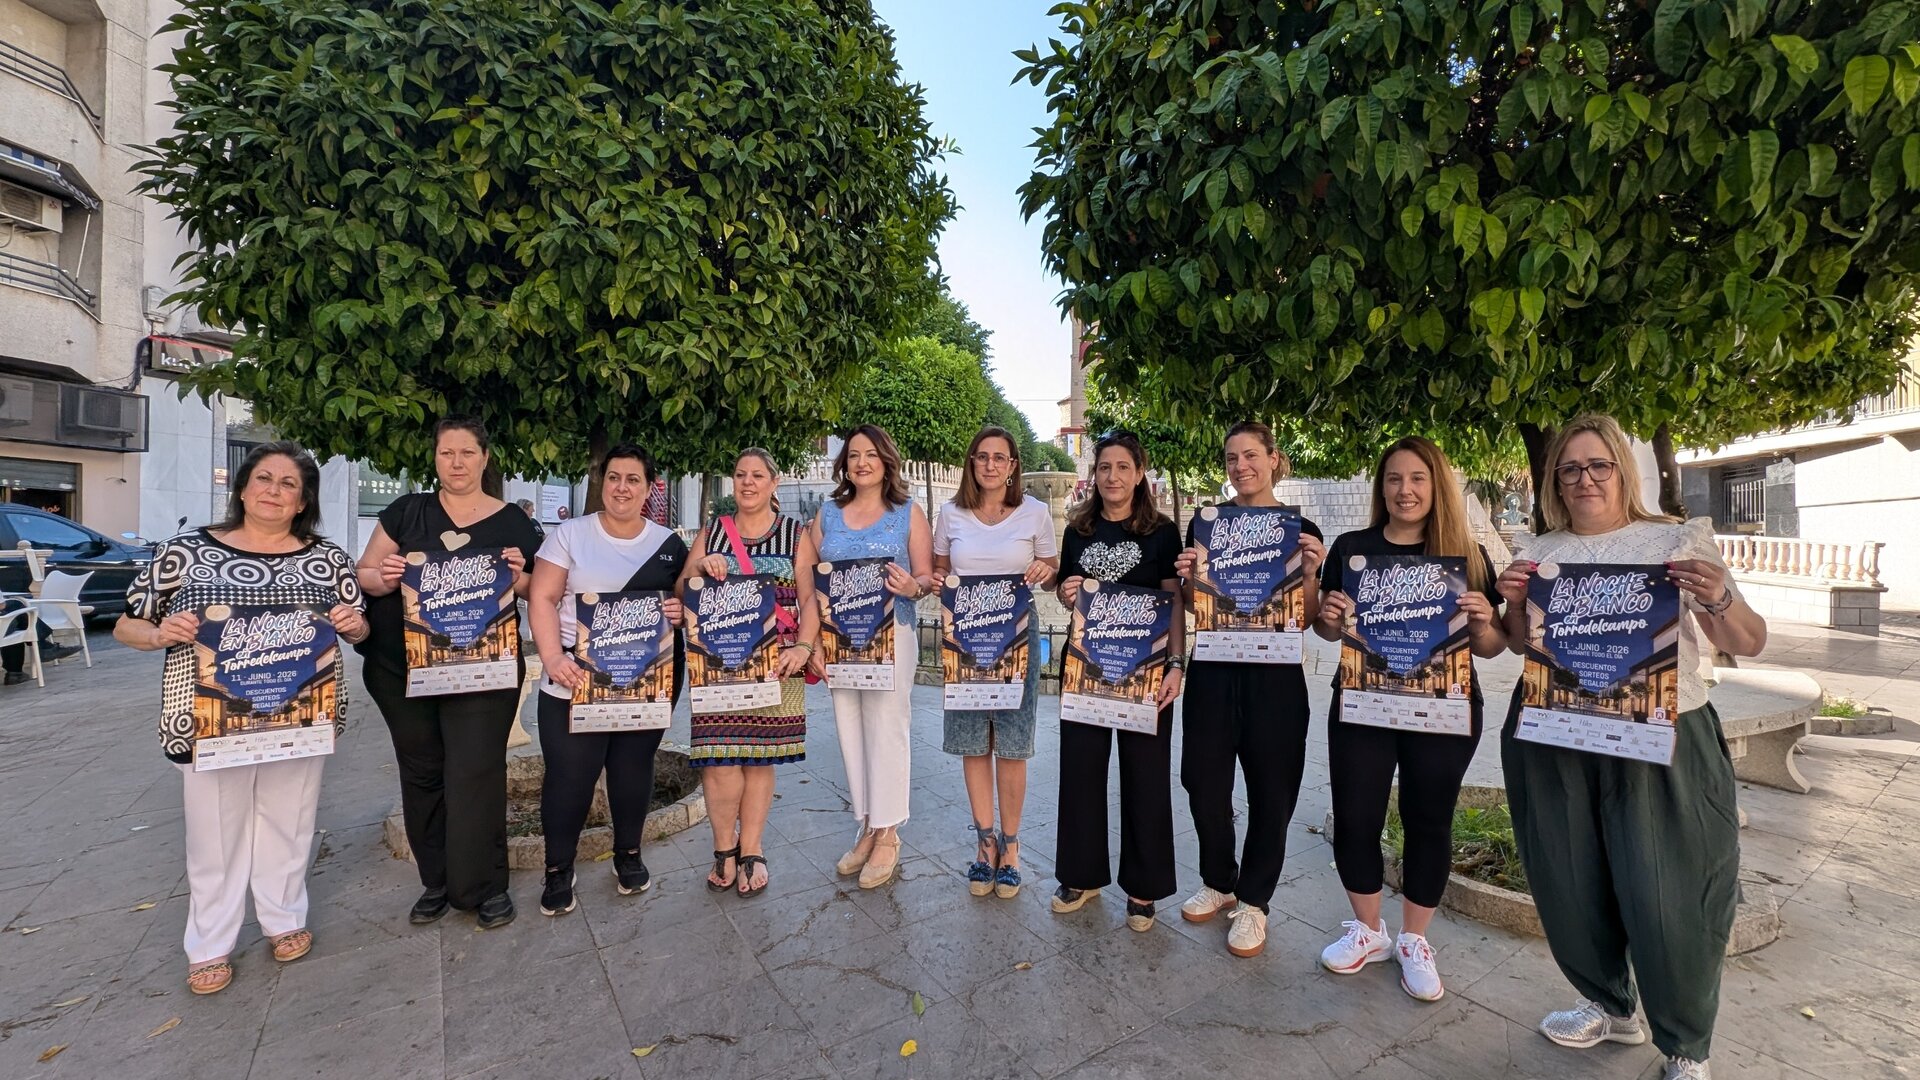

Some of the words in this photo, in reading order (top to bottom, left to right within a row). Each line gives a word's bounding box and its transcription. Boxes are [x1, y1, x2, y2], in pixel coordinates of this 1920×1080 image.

[1212, 519, 1229, 537] LA
[1230, 513, 1281, 534] NOCHE
[1210, 537, 1226, 550] EN
[1227, 528, 1284, 552] BLANCO
[422, 563, 440, 580] LA
[441, 555, 492, 577] NOCHE
[1211, 549, 1282, 571] Torredelcampo
[420, 580, 438, 593] EN
[438, 569, 496, 593] BLANCO
[1359, 570, 1379, 589] LA
[1380, 563, 1442, 586] NOCHE
[1551, 578, 1575, 599] LA
[1577, 572, 1648, 597] NOCHE
[423, 587, 495, 612] Torredelcampo
[699, 587, 715, 604] LA
[715, 580, 758, 601] NOCHE
[955, 586, 970, 602] LA
[971, 580, 1012, 599] NOCHE
[1090, 592, 1108, 609] LA
[1108, 591, 1156, 609] NOCHE
[1358, 589, 1377, 602] EN
[1378, 582, 1447, 606] BLANCO
[594, 602, 610, 618] LA
[611, 597, 658, 616] NOCHE
[698, 602, 713, 615] EN
[714, 594, 762, 616] BLANCO
[954, 600, 968, 613] EN
[969, 595, 1015, 615] BLANCO
[1360, 606, 1444, 626] Torredelcampo
[1548, 598, 1571, 613] EN
[1574, 594, 1653, 618] BLANCO
[222, 619, 246, 638] LA
[248, 610, 312, 633] NOCHE
[592, 617, 608, 630] EN
[609, 612, 660, 632] BLANCO
[701, 612, 760, 634] Torredelcampo
[956, 612, 1013, 632] Torredelcampo
[1087, 608, 1104, 620] EN
[1105, 610, 1157, 625] BLANCO
[219, 635, 243, 652] EN
[243, 626, 316, 652] BLANCO
[1087, 627, 1151, 640] Torredelcampo
[1549, 618, 1648, 638] Torredelcampo
[592, 630, 657, 649] Torredelcampo
[1607, 646, 1629, 654] 2026
[221, 647, 312, 674] Torredelcampo
[1573, 662, 1616, 671] DESCUENTOS
[1579, 671, 1609, 679] SORTEOS
[1579, 679, 1609, 688] REGALOS
